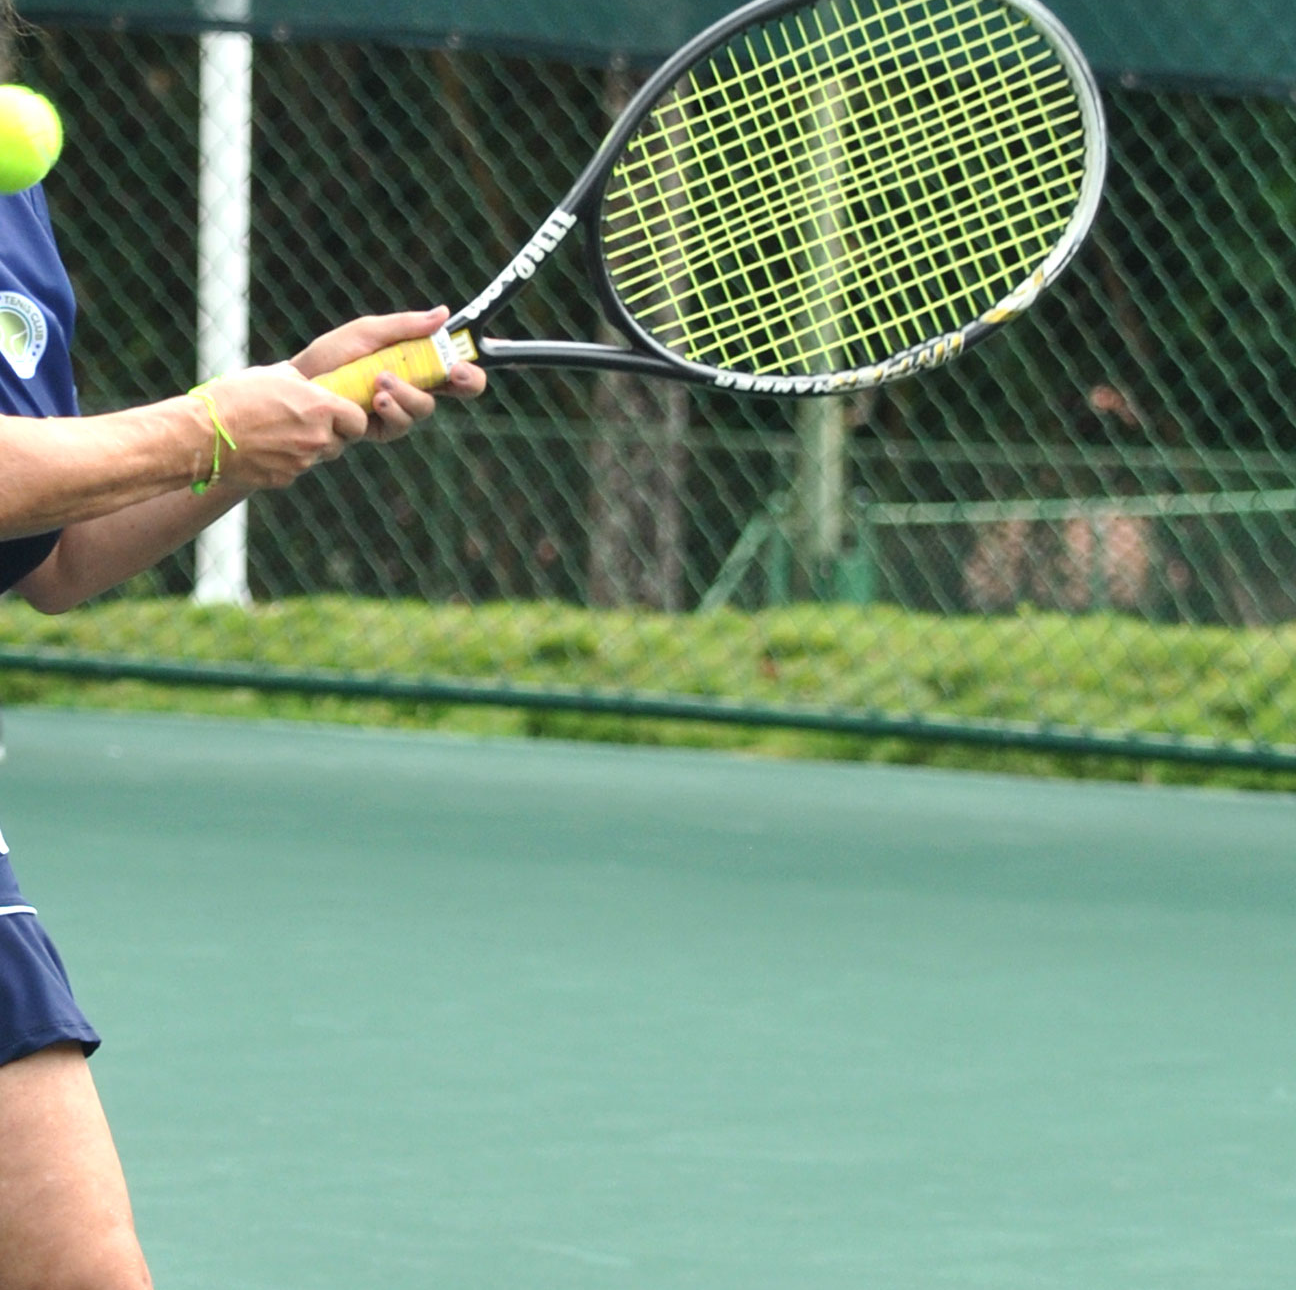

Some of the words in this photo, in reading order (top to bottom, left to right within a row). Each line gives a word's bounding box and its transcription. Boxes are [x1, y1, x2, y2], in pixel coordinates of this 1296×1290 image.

[465, 207, 577, 320] Wilson
[31, 313, 44, 341] CLUB
[714, 373, 832, 395] HAMMER
